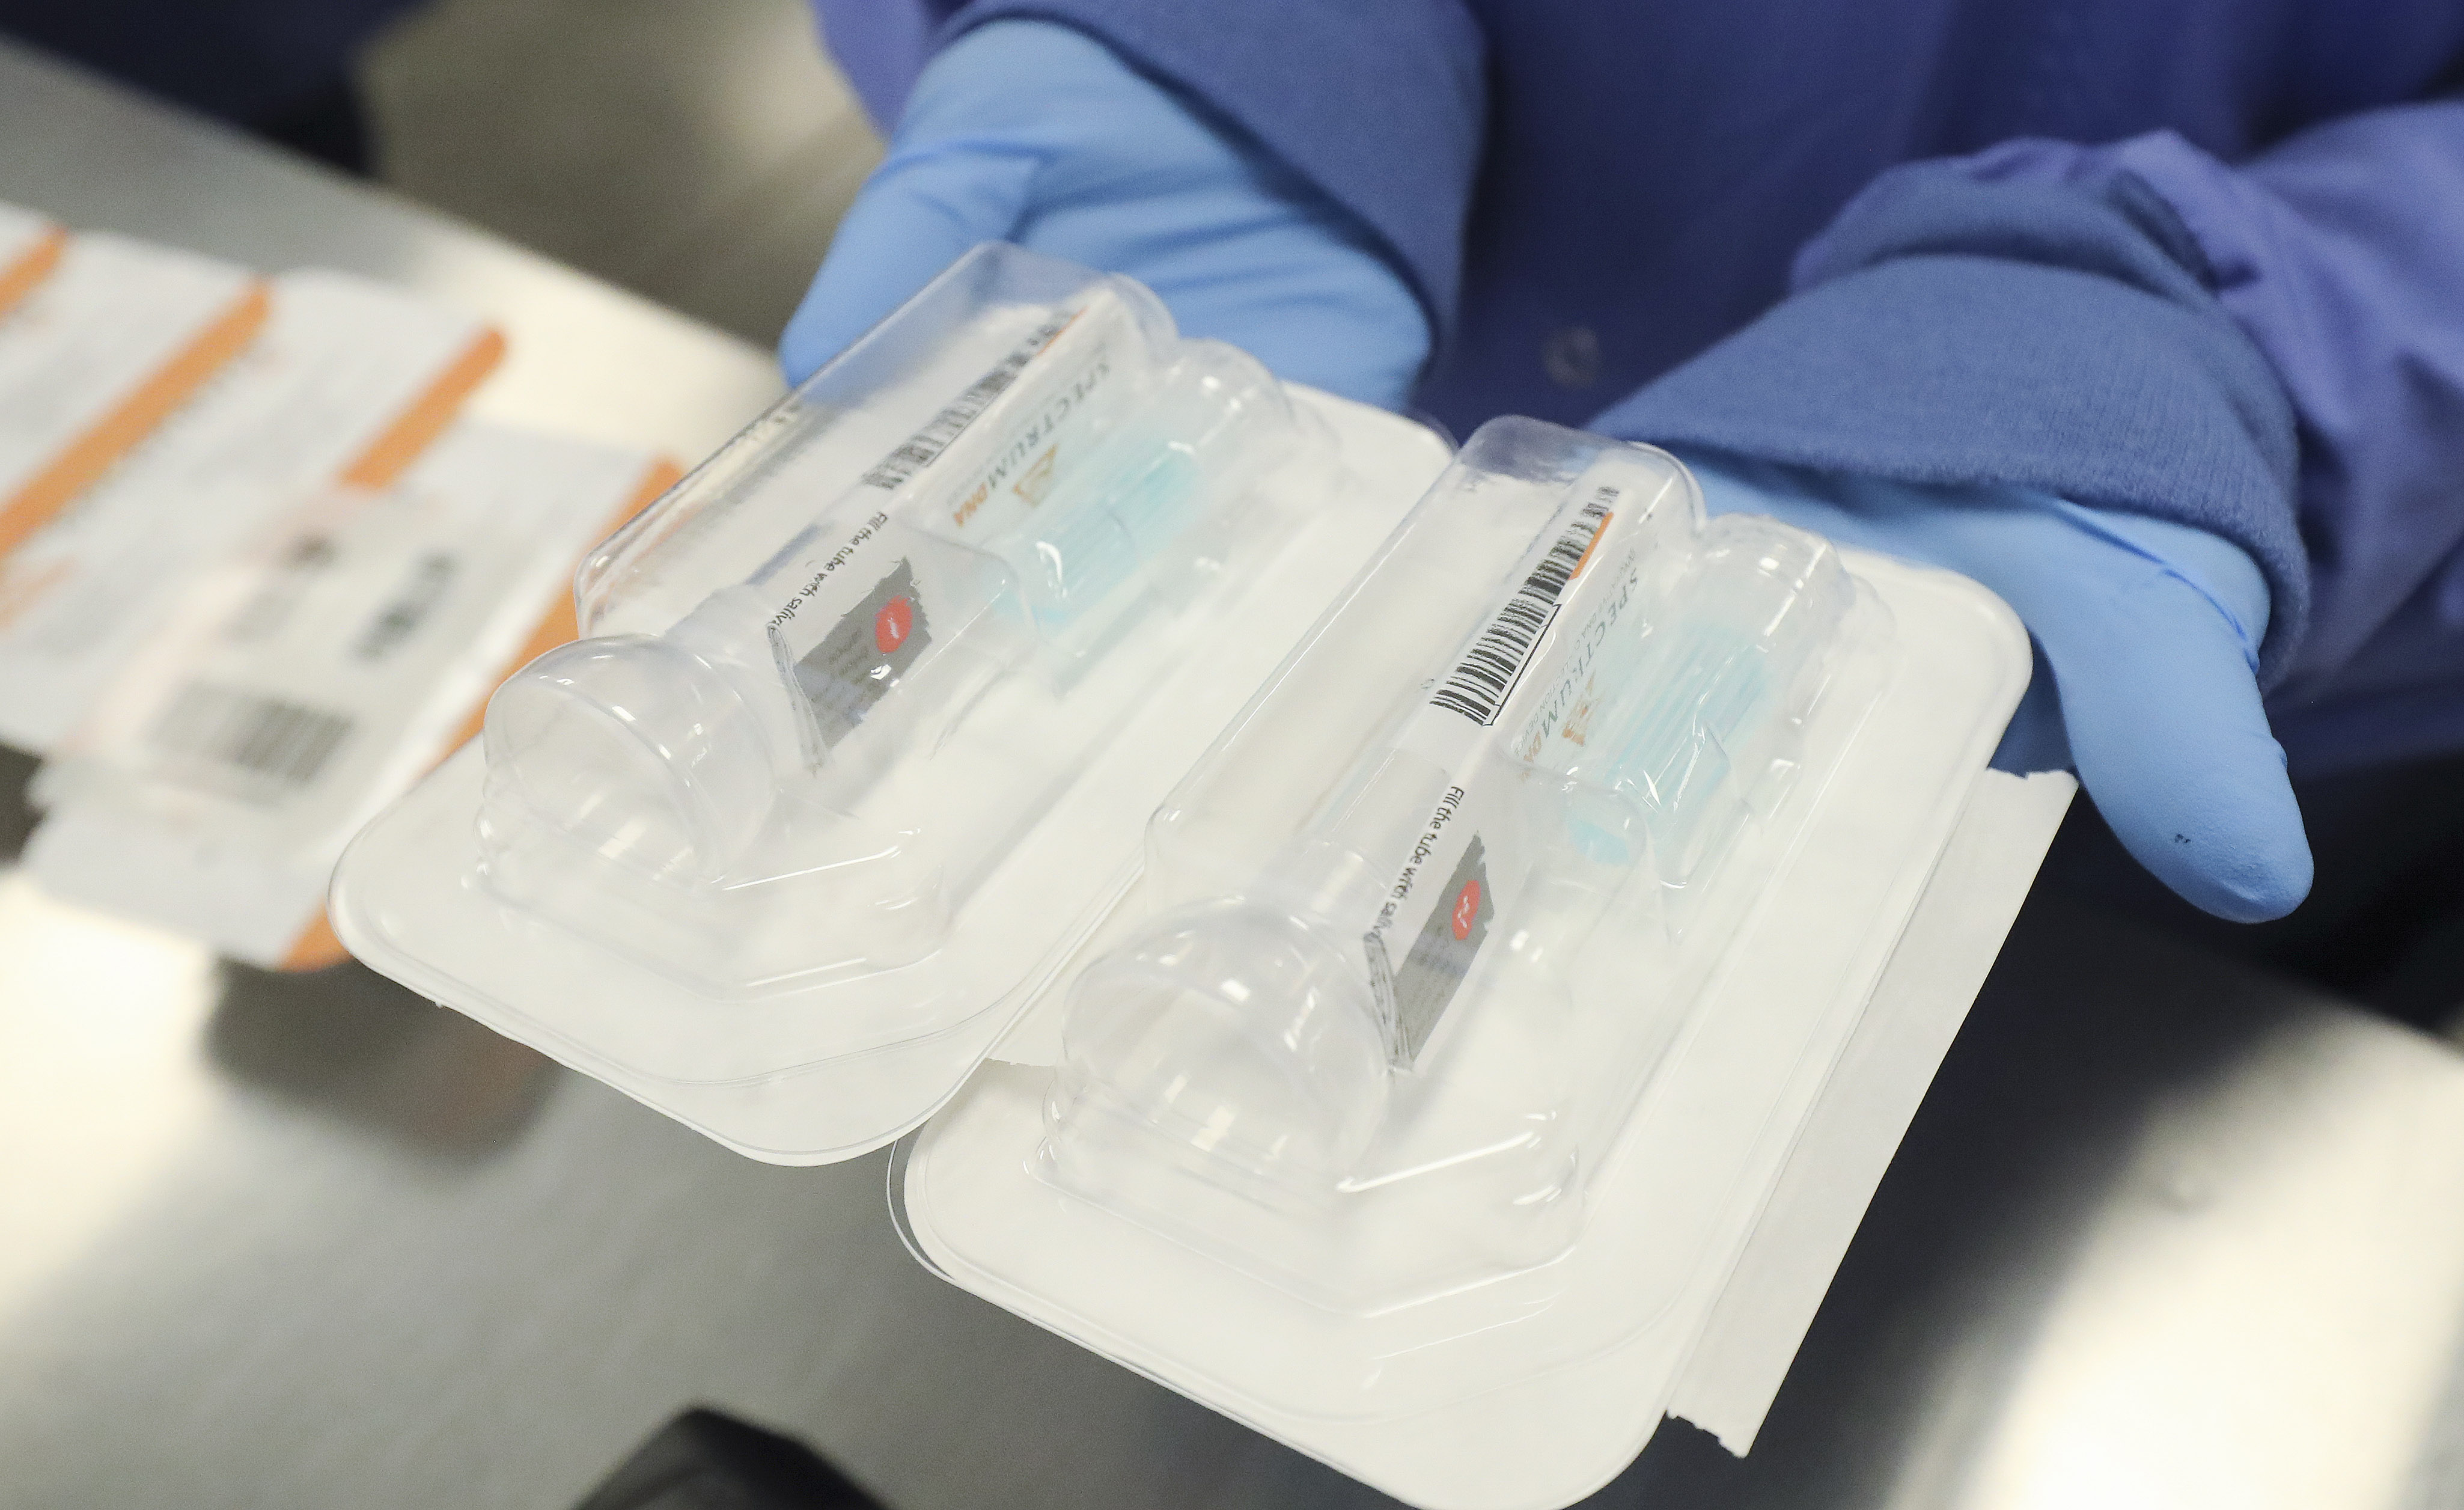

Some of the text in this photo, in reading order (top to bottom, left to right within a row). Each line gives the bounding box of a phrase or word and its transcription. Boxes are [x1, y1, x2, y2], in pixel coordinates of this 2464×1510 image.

[867, 510, 888, 531] Fill
[849, 527, 872, 546] the
[823, 546, 855, 572] tube
[1442, 786, 1465, 810] Fill
[1430, 807, 1452, 830] the
[1409, 832, 1438, 865] tube
